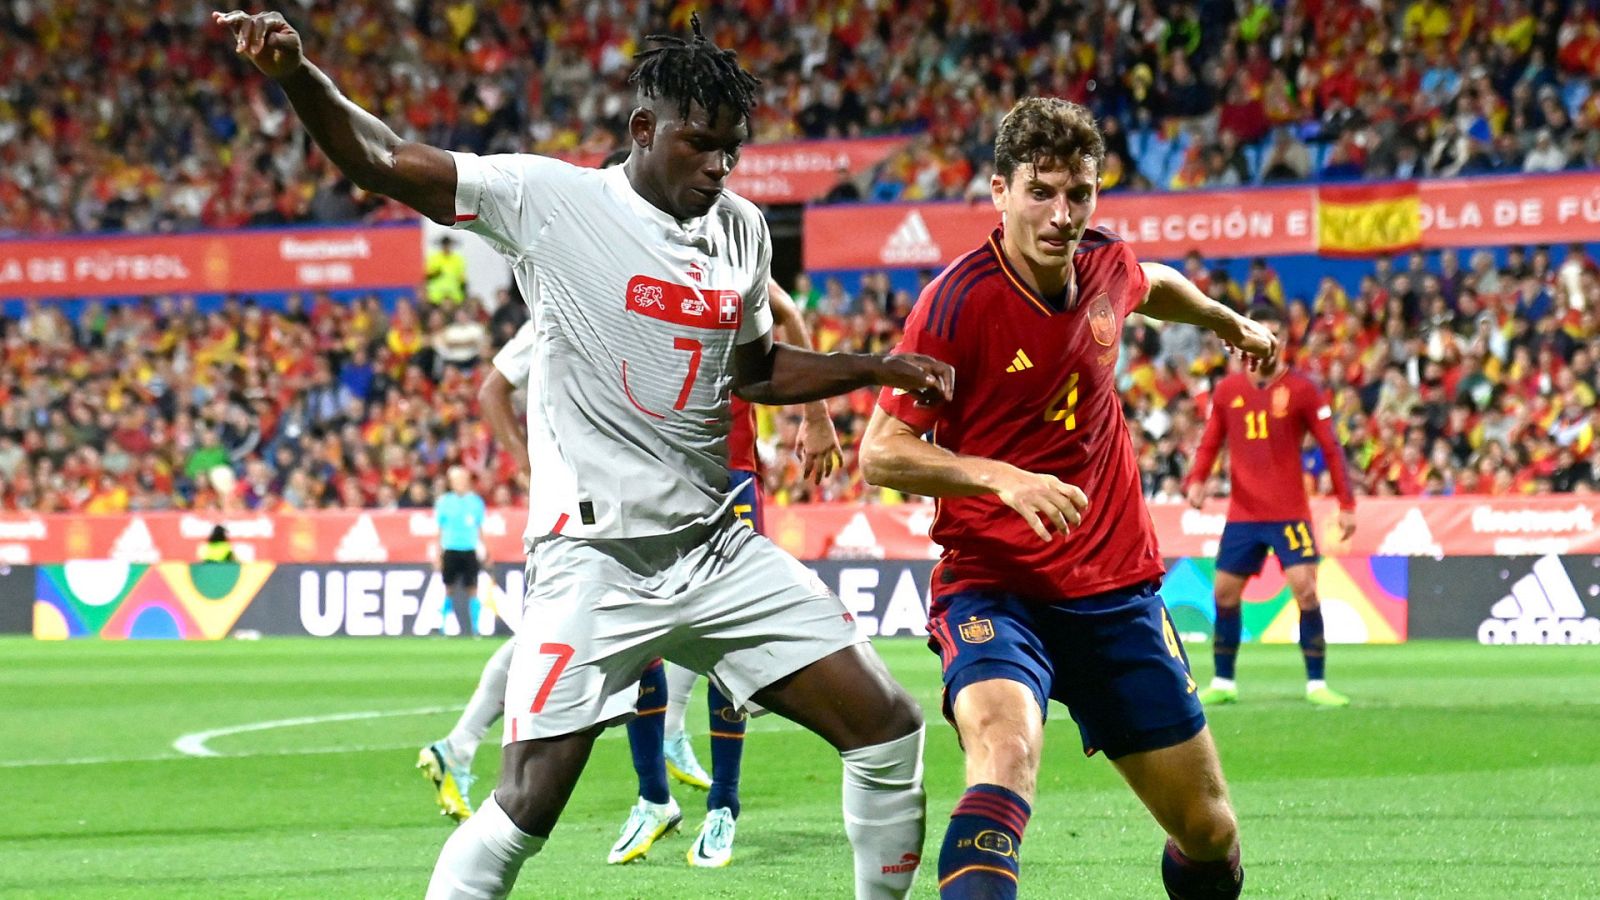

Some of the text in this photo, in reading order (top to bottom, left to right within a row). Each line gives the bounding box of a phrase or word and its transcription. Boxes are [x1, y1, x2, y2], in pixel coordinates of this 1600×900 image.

[1494, 198, 1543, 227] DE
[673, 337, 703, 410] 7
[1044, 372, 1079, 431] 4
[1245, 410, 1268, 440] 11
[299, 569, 461, 637] UEFA
[530, 642, 575, 713] 7
